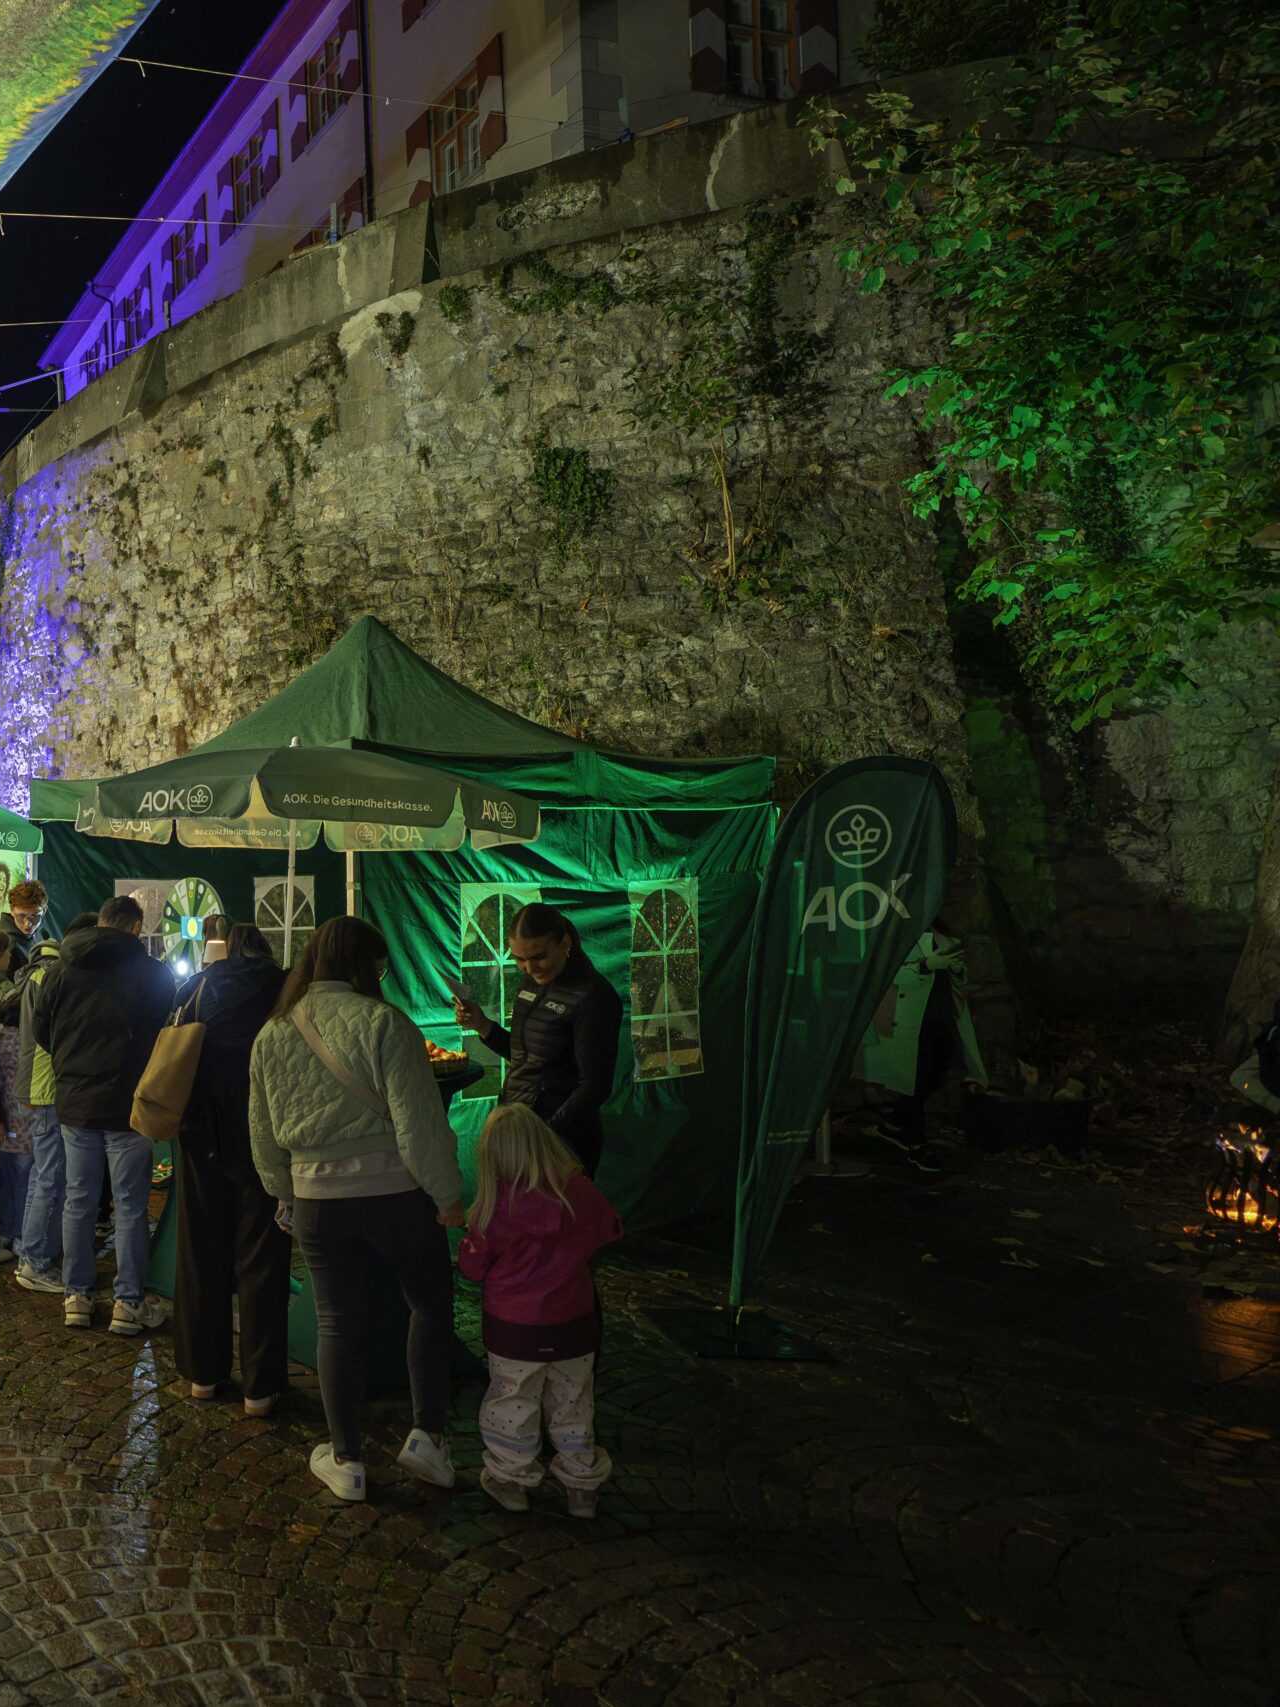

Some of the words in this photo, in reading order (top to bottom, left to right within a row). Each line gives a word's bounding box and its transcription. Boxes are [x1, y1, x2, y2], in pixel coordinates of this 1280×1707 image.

[137, 788, 186, 813] AOK
[282, 793, 311, 804] AOK.
[313, 794, 330, 805] Die
[331, 796, 433, 812] Gesundheitskasse.
[800, 873, 913, 935] AOK
